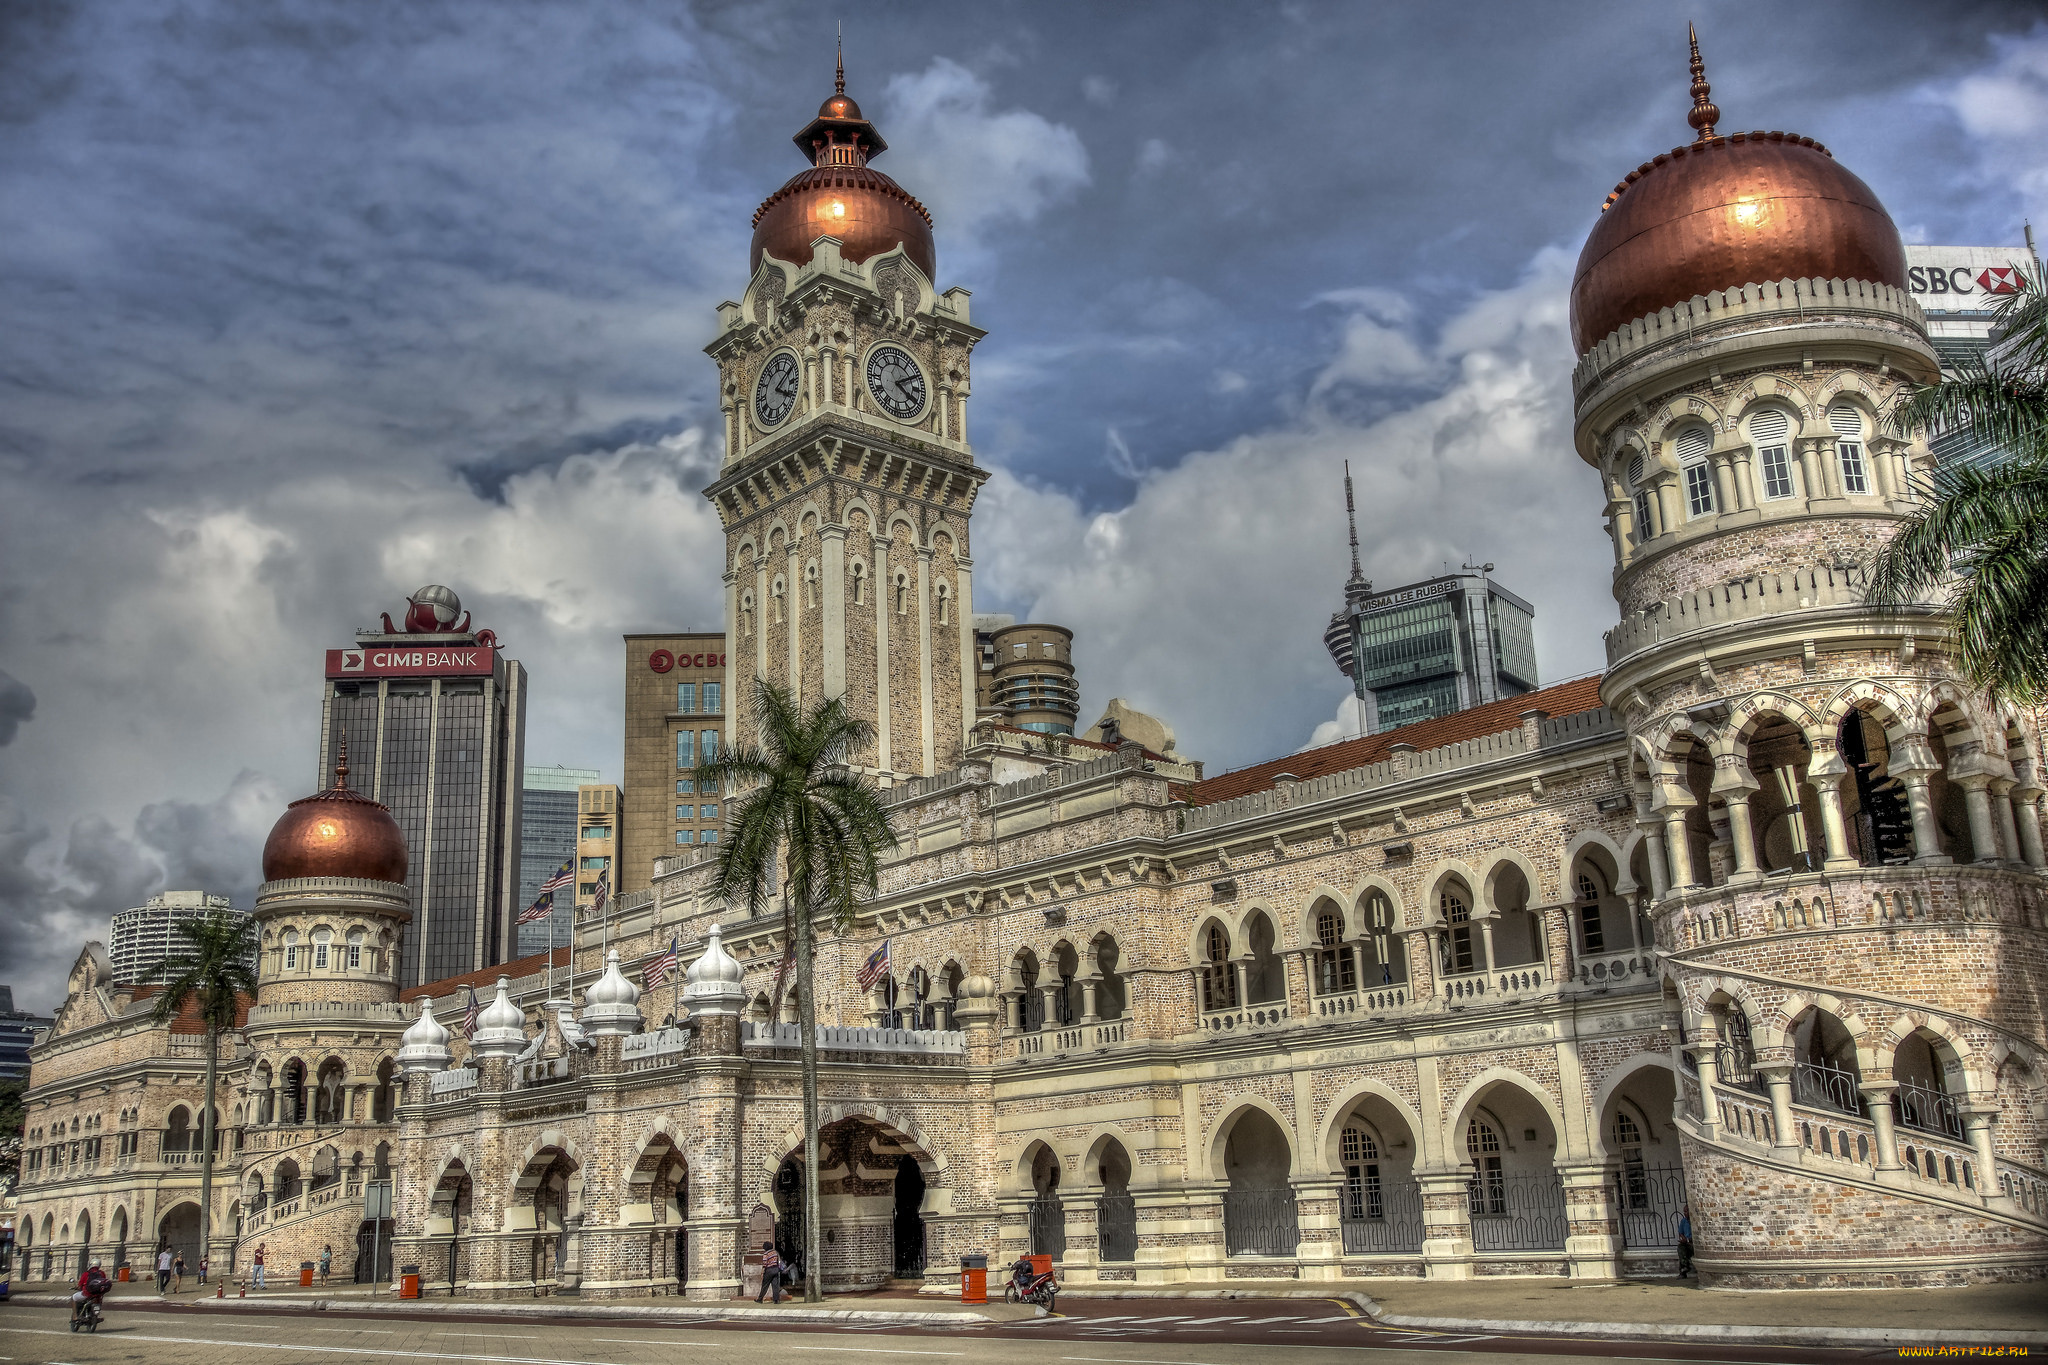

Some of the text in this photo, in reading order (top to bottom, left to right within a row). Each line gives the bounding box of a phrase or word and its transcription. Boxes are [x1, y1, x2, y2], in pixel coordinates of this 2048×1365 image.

[1909, 266, 1974, 295] SBC
[1360, 581, 1458, 611] WISMA LEE RUBBER
[373, 652, 477, 667] CIMB BANK
